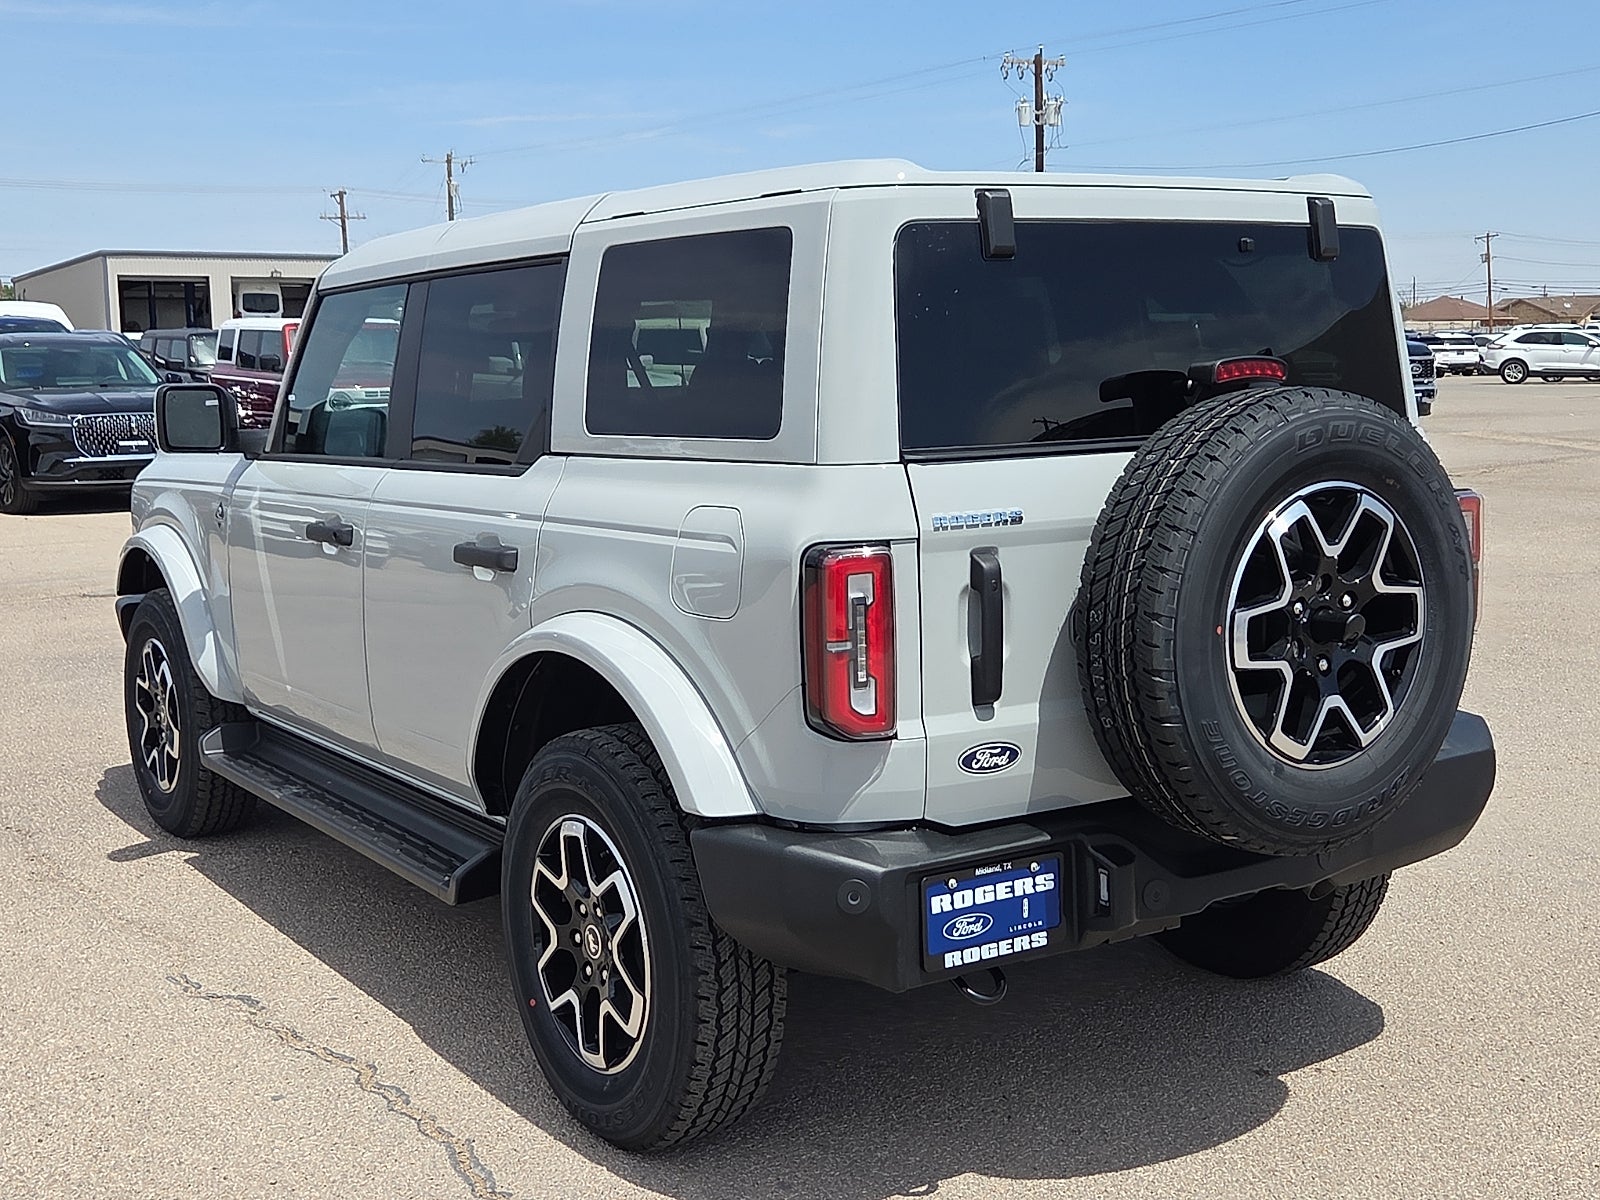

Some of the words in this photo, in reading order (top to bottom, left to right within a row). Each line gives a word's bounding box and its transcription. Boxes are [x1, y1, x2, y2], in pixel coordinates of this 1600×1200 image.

[1295, 420, 1451, 510] DUELER
[932, 509, 1023, 532] ROGERS
[971, 747, 1011, 769] Ford
[1201, 719, 1411, 830] BRIDGESTONE
[1003, 862, 1012, 872] TX
[931, 873, 1055, 914] ROGERS
[952, 916, 983, 937] Ford
[1009, 920, 1043, 932] LINCOLN
[944, 931, 1048, 968] ROGERS
